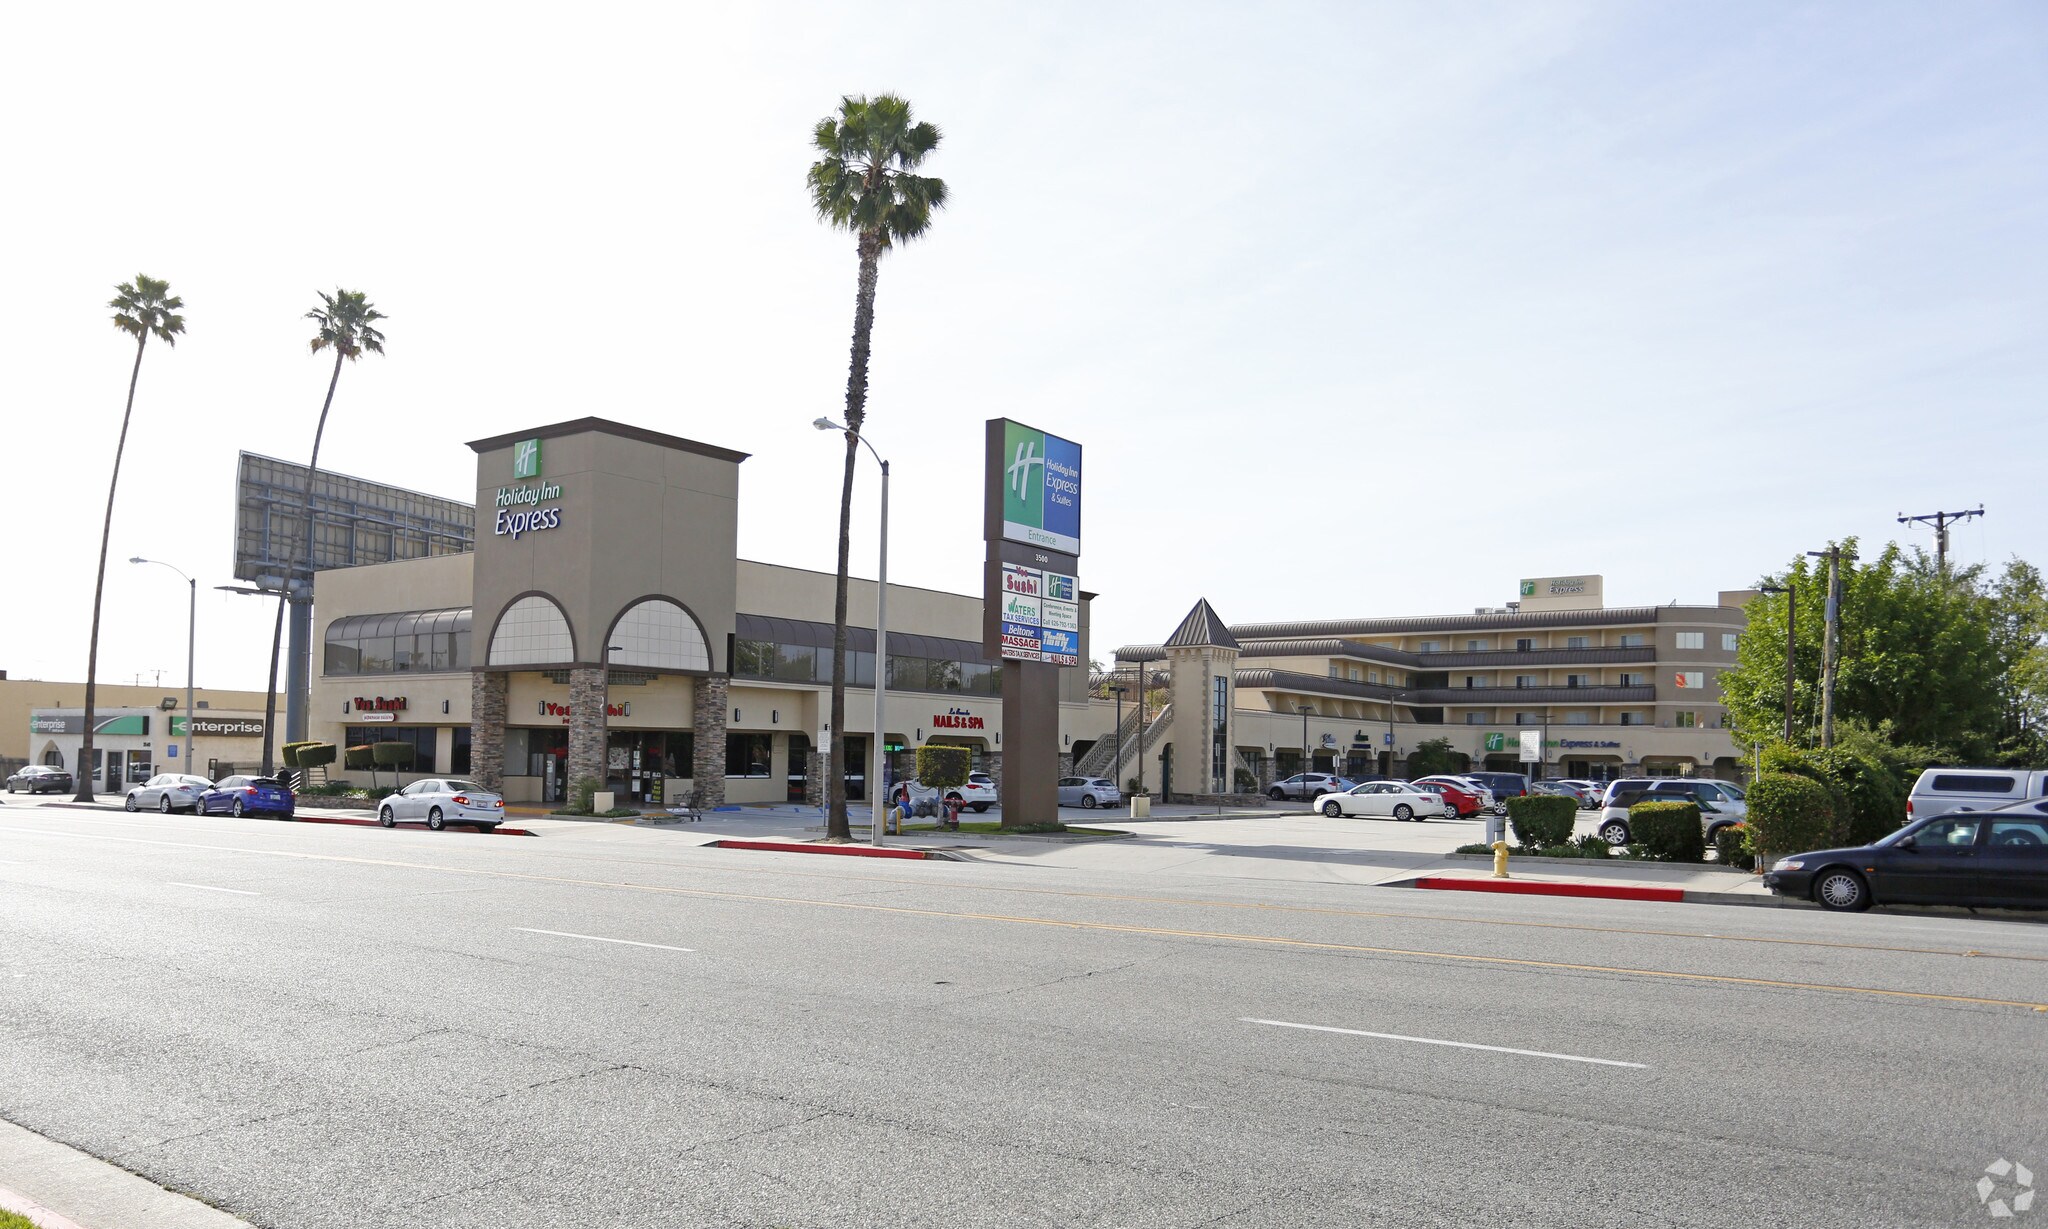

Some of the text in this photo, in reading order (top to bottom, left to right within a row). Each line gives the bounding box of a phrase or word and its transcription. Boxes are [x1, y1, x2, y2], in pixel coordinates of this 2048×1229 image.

[1046, 458, 1078, 479] Holiday Inn
[1046, 473, 1078, 495] Express
[496, 481, 560, 507] Holiday Inn
[1051, 492, 1072, 507] & Suites
[495, 508, 560, 539] Express
[1028, 530, 1057, 546] Entrance
[1035, 553, 1049, 563] 3500
[1016, 566, 1028, 577] Yes
[1007, 574, 1038, 594] Sushi
[1549, 586, 1584, 595] Express
[1003, 613, 1040, 625] TAX SERVICES
[1008, 625, 1035, 637] Beltone
[1002, 635, 1039, 649] MASSAGE
[1043, 631, 1069, 651] Thrifty
[1051, 654, 1064, 664] NAILS
[354, 696, 407, 710] Yes Sushi
[547, 702, 571, 716] Yes
[32, 719, 65, 731] enterprise
[176, 721, 263, 734] enterprise
[933, 715, 984, 729] NAILS & SPA
[1560, 739, 1593, 750] Express
[1600, 740, 1621, 748] Suites
